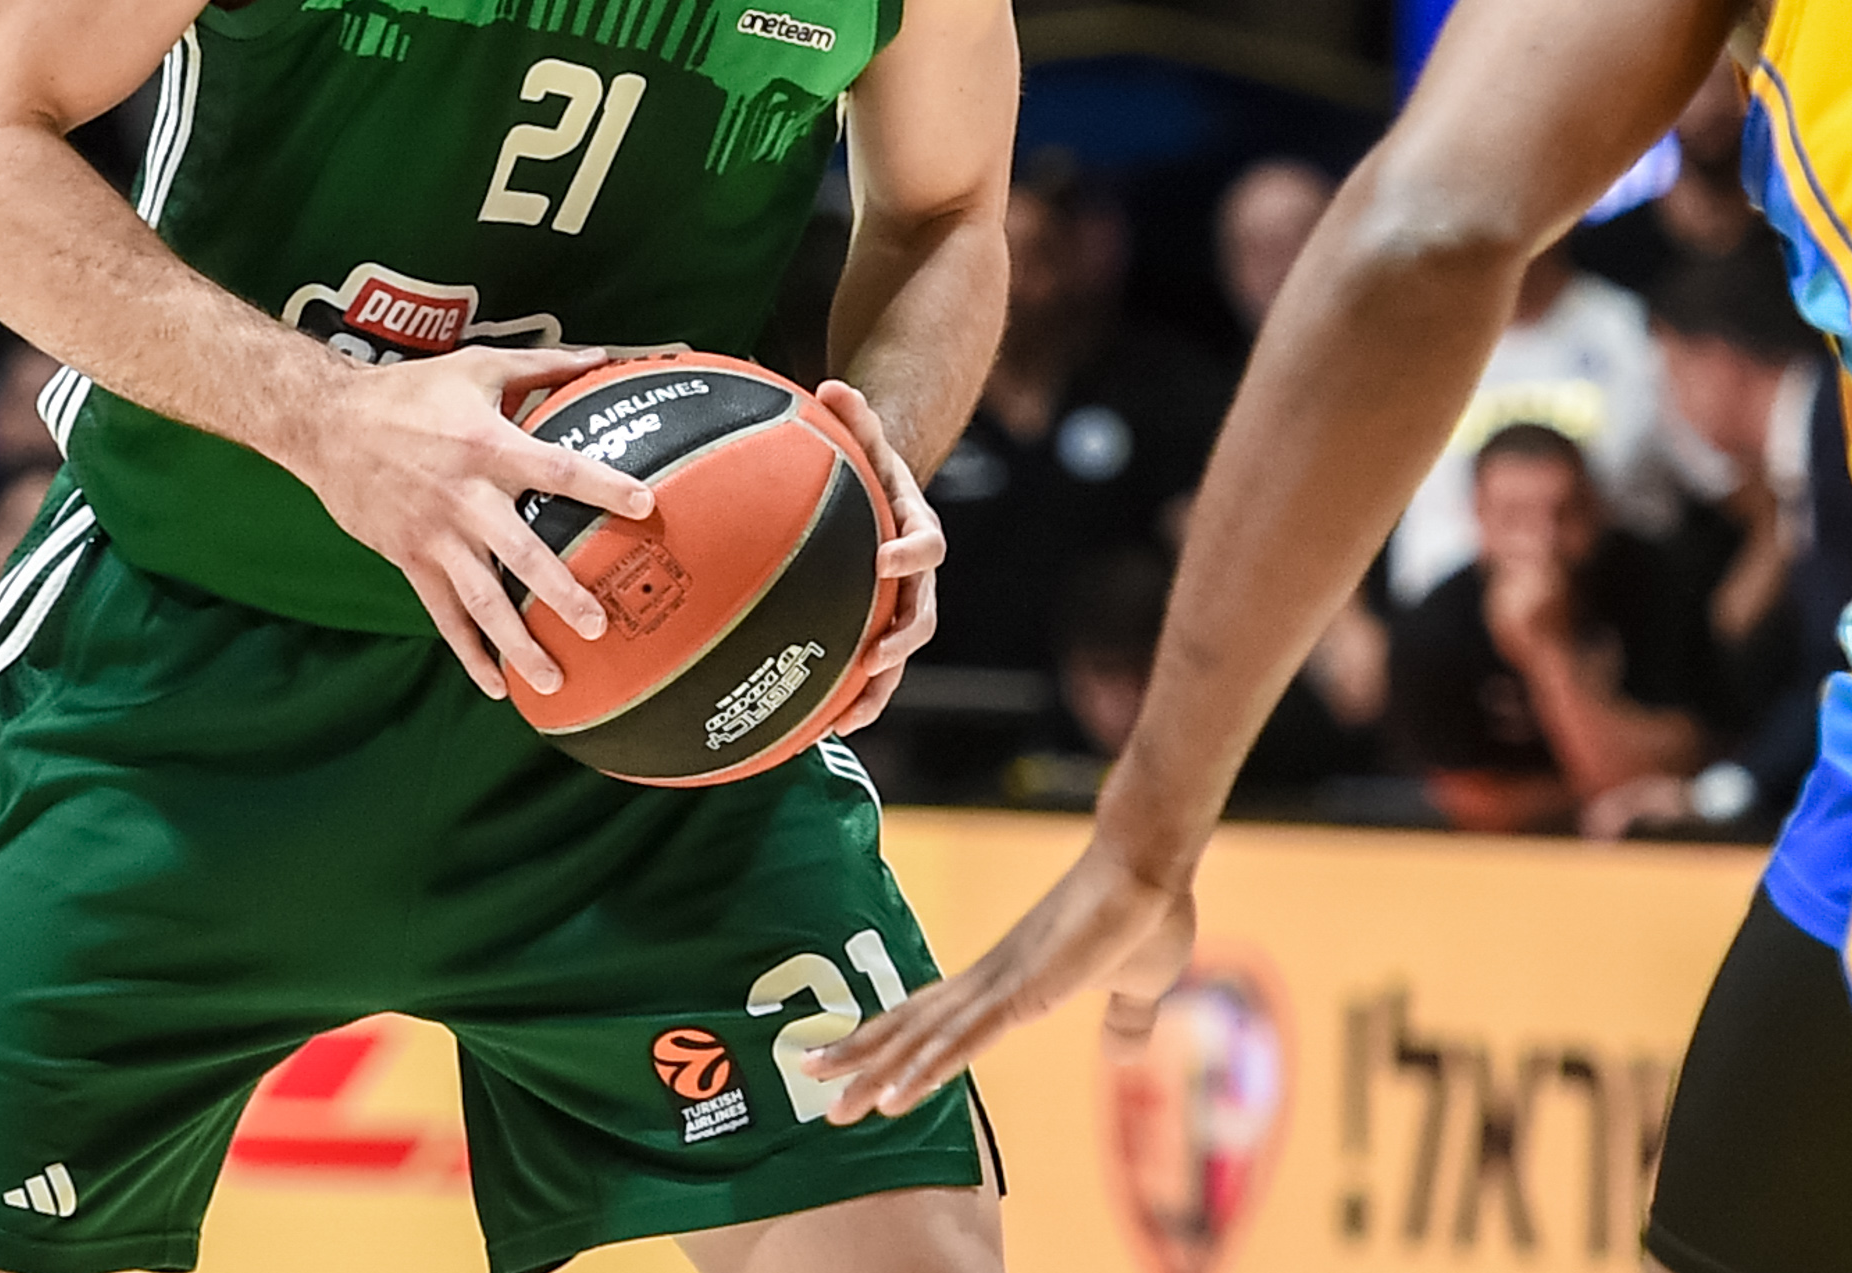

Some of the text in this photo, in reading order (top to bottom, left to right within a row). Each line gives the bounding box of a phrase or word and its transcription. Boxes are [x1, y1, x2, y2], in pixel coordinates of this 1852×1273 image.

[478, 58, 647, 236] 21
[355, 289, 460, 342] pame
[588, 379, 710, 435] AIRLINES
[706, 641, 826, 750] LEGACY
[681, 1088, 744, 1121] TURKISH
[685, 1102, 748, 1134] AIRLINES
[1343, 986, 1673, 1260] ראל!
